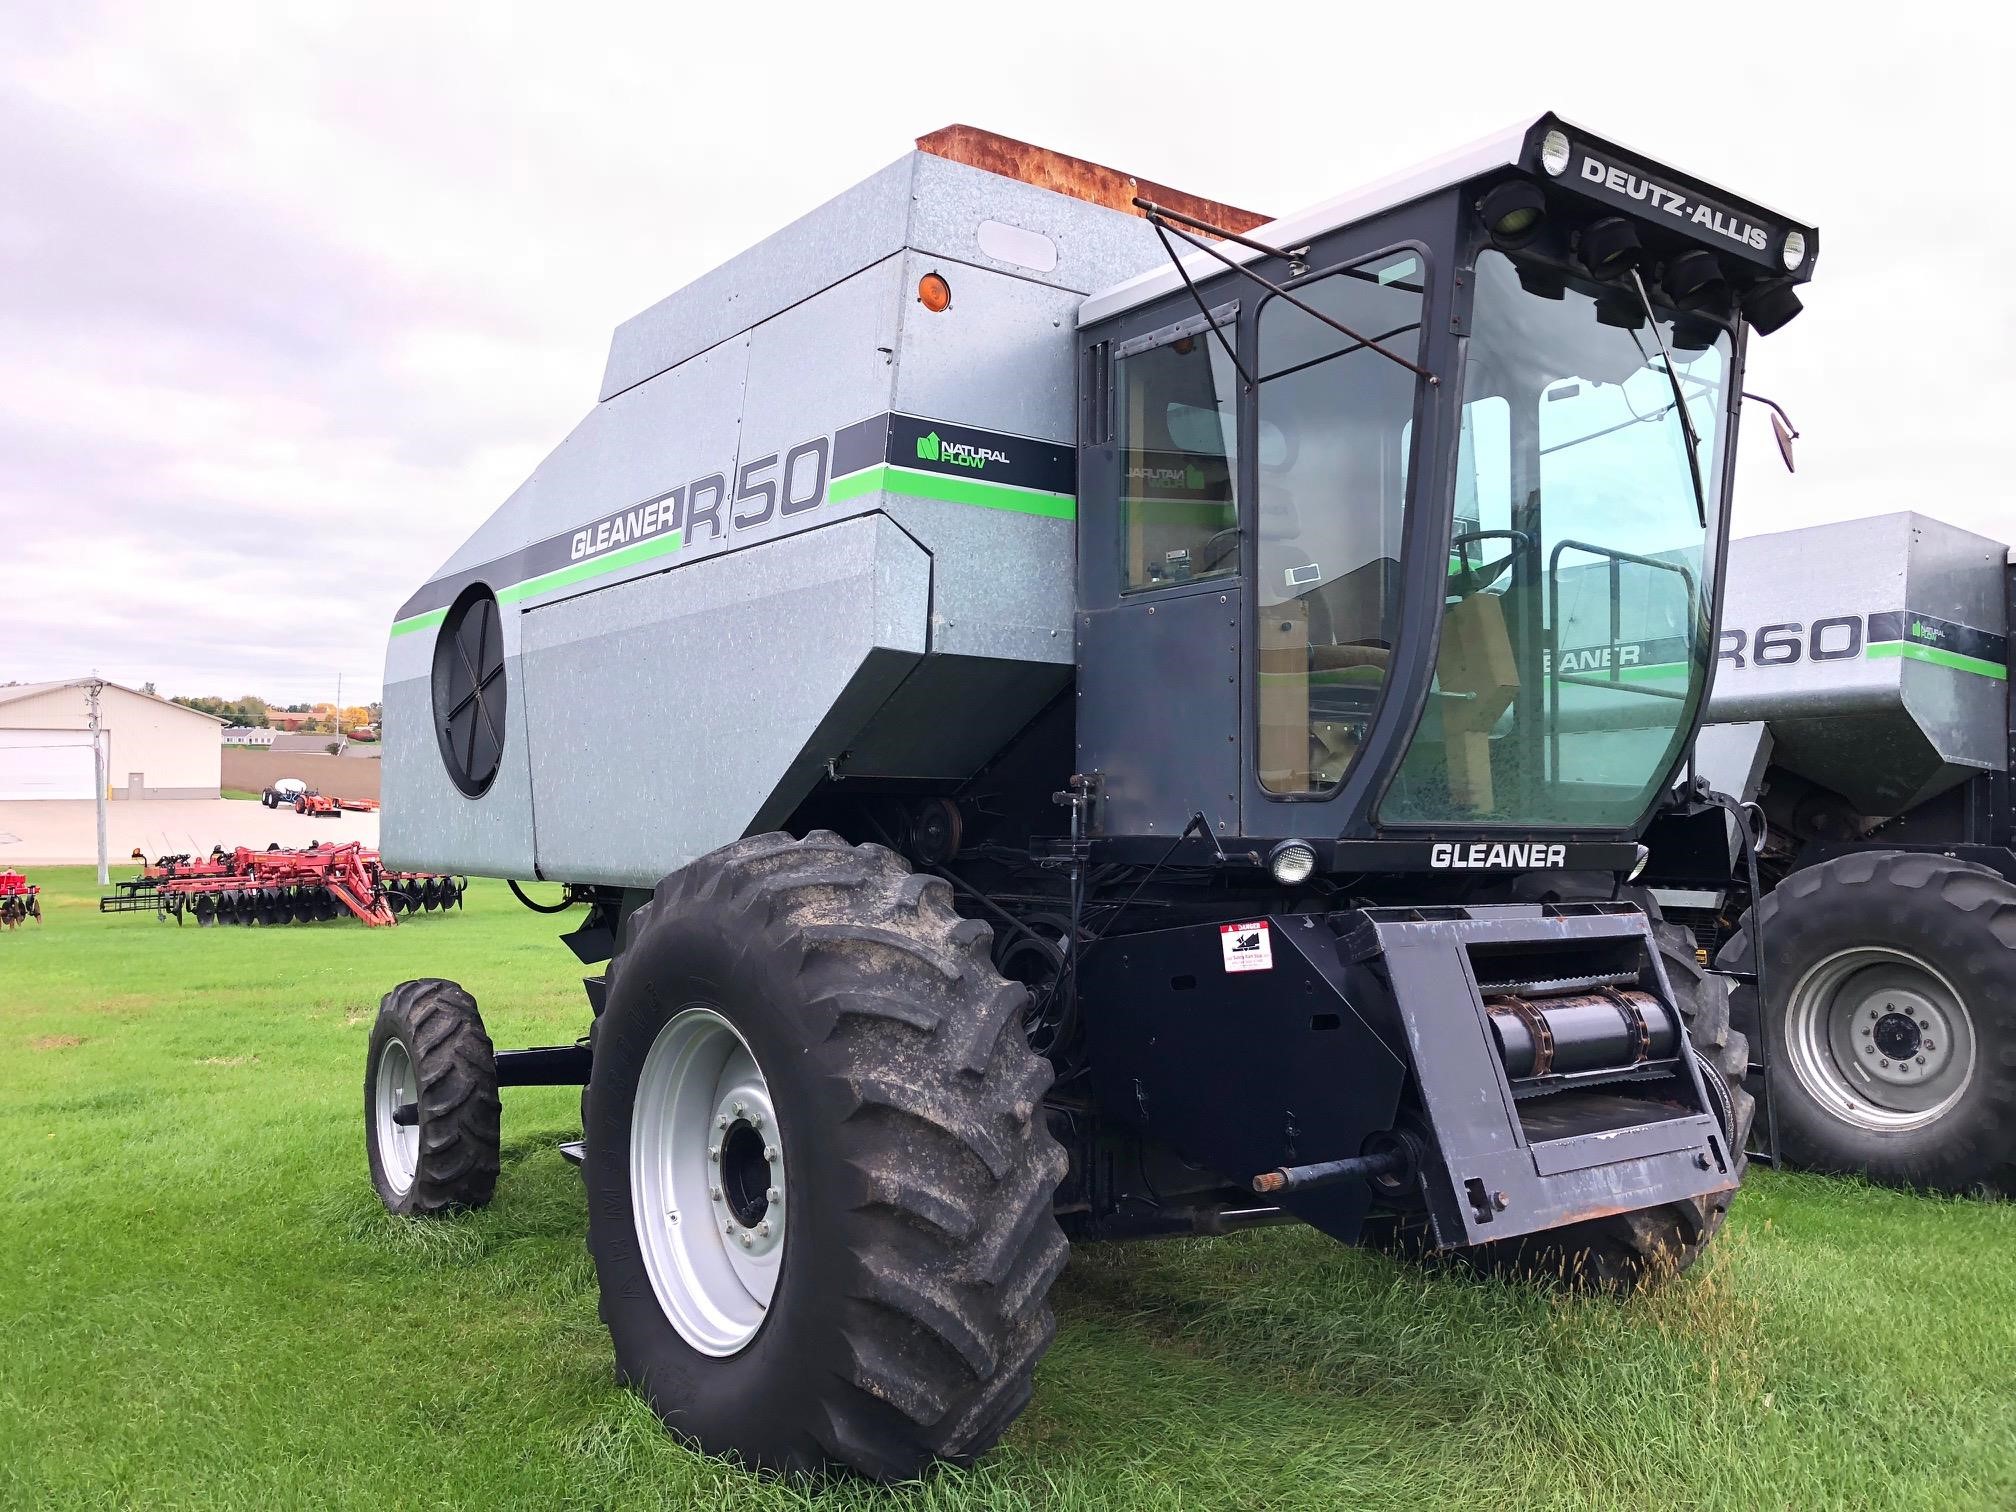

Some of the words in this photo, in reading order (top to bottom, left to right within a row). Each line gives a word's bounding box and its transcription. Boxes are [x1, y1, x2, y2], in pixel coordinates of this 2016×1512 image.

[1581, 156, 1768, 250] DEUTZ-ALLIS
[941, 441, 1010, 464] NATURAL
[941, 451, 986, 469] FLOW
[683, 434, 829, 548] R50
[570, 497, 675, 561] GLEANER
[1543, 645, 1640, 674] EANER
[1717, 614, 1864, 669] R60
[1430, 843, 1566, 868] GLEANER
